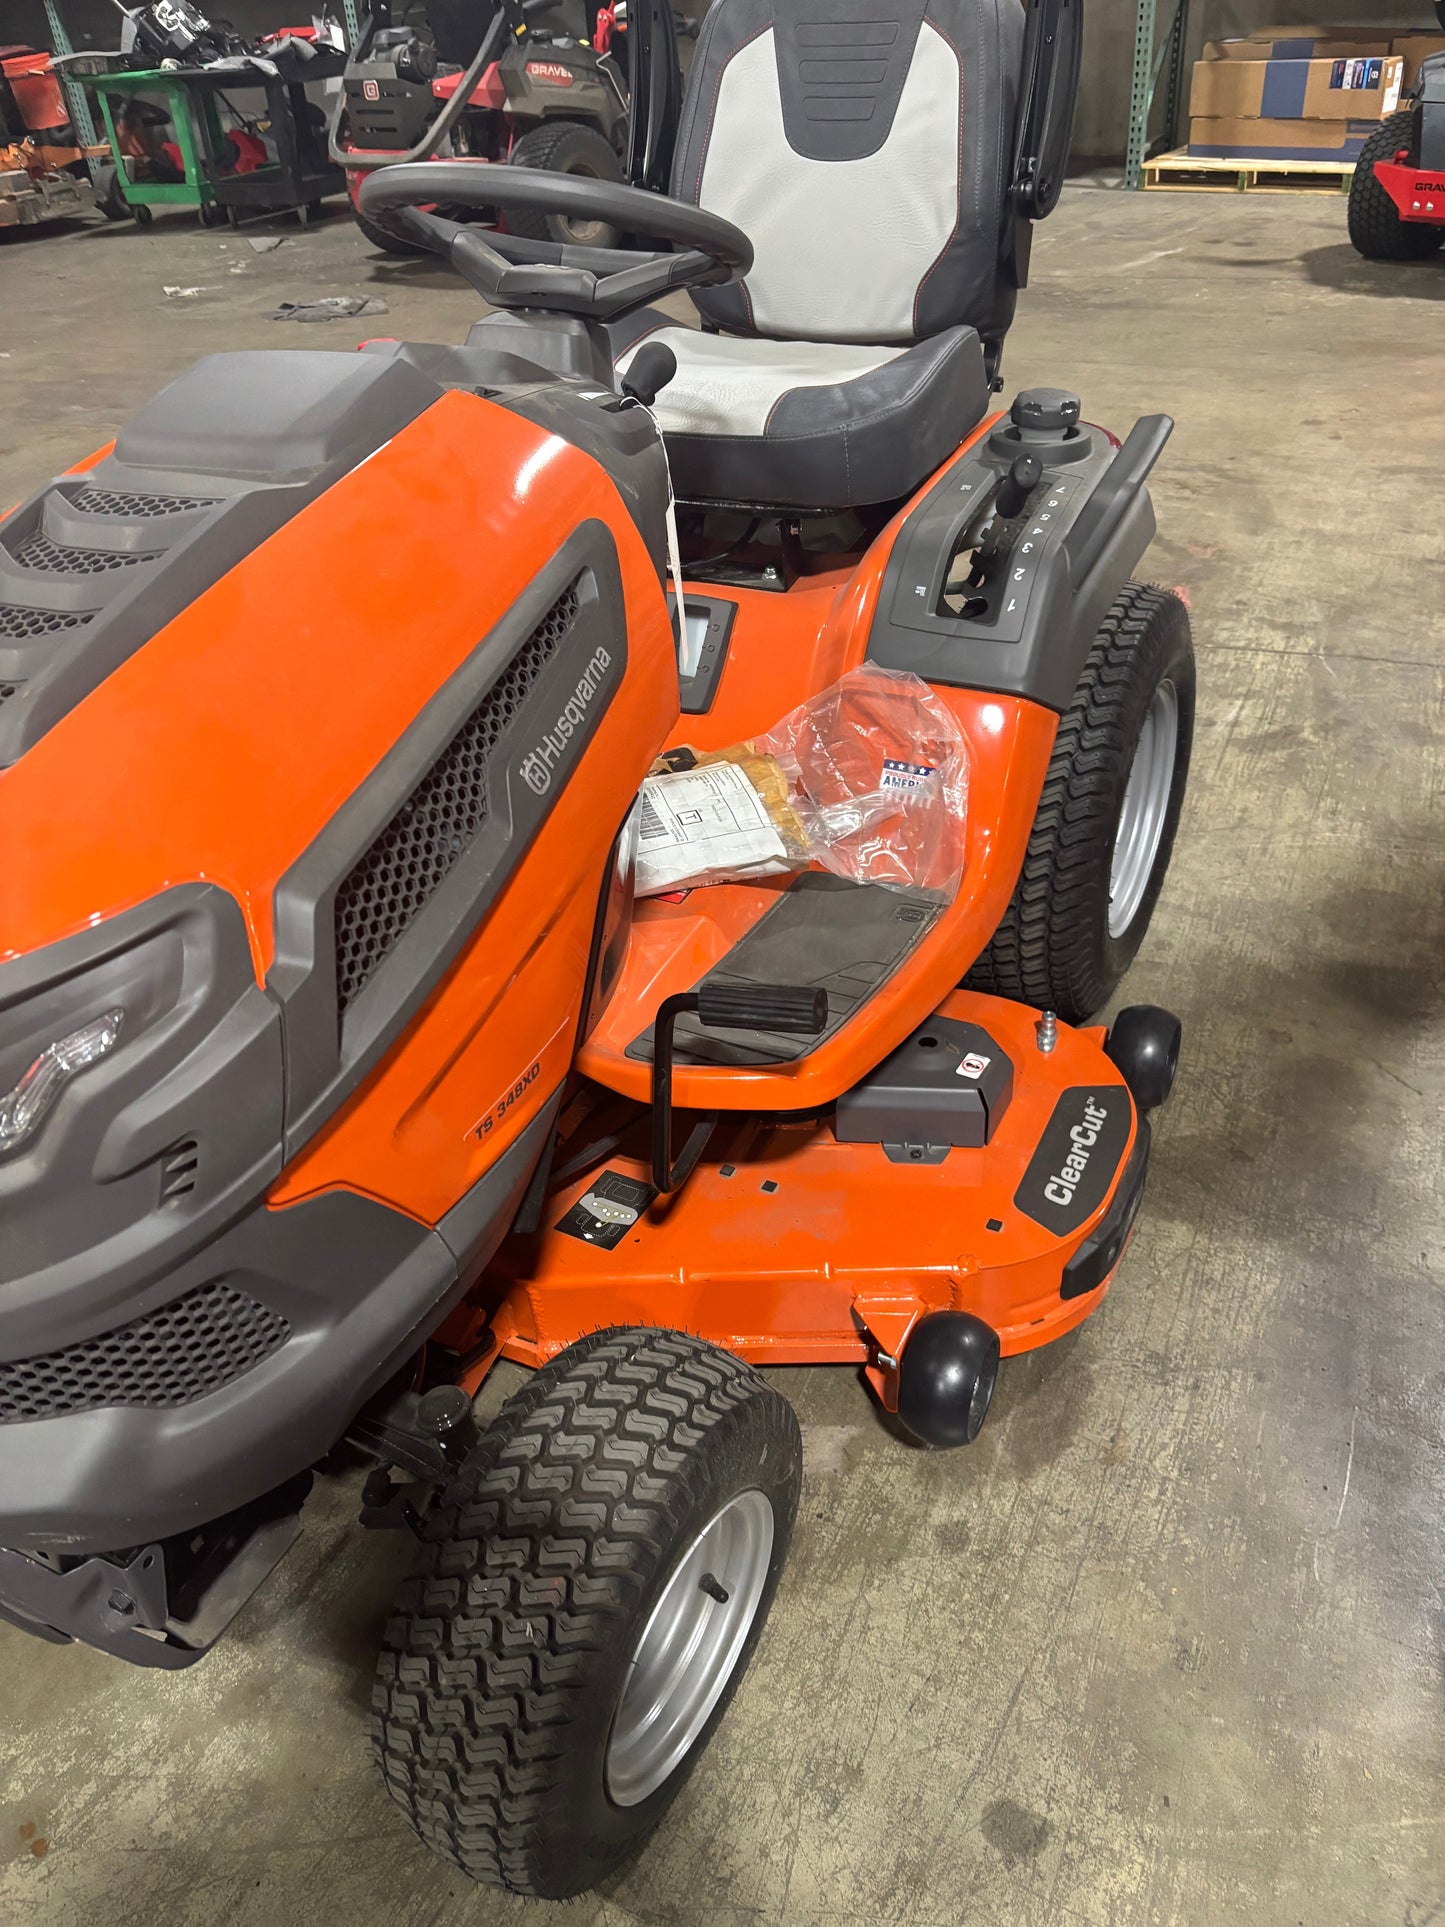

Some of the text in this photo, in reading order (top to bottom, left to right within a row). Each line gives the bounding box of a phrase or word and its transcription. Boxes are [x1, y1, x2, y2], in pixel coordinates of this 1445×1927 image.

[1055, 486, 1066, 494] 7
[1048, 499, 1058, 507] 6
[1039, 513, 1051, 521] 5
[1032, 527, 1043, 535] 4
[1021, 542, 1034, 553] 3
[1013, 568, 1026, 581] 2
[1007, 598, 1016, 612] 1
[536, 645, 612, 770] Husqvarna
[475, 1063, 541, 1141] TS 348XD
